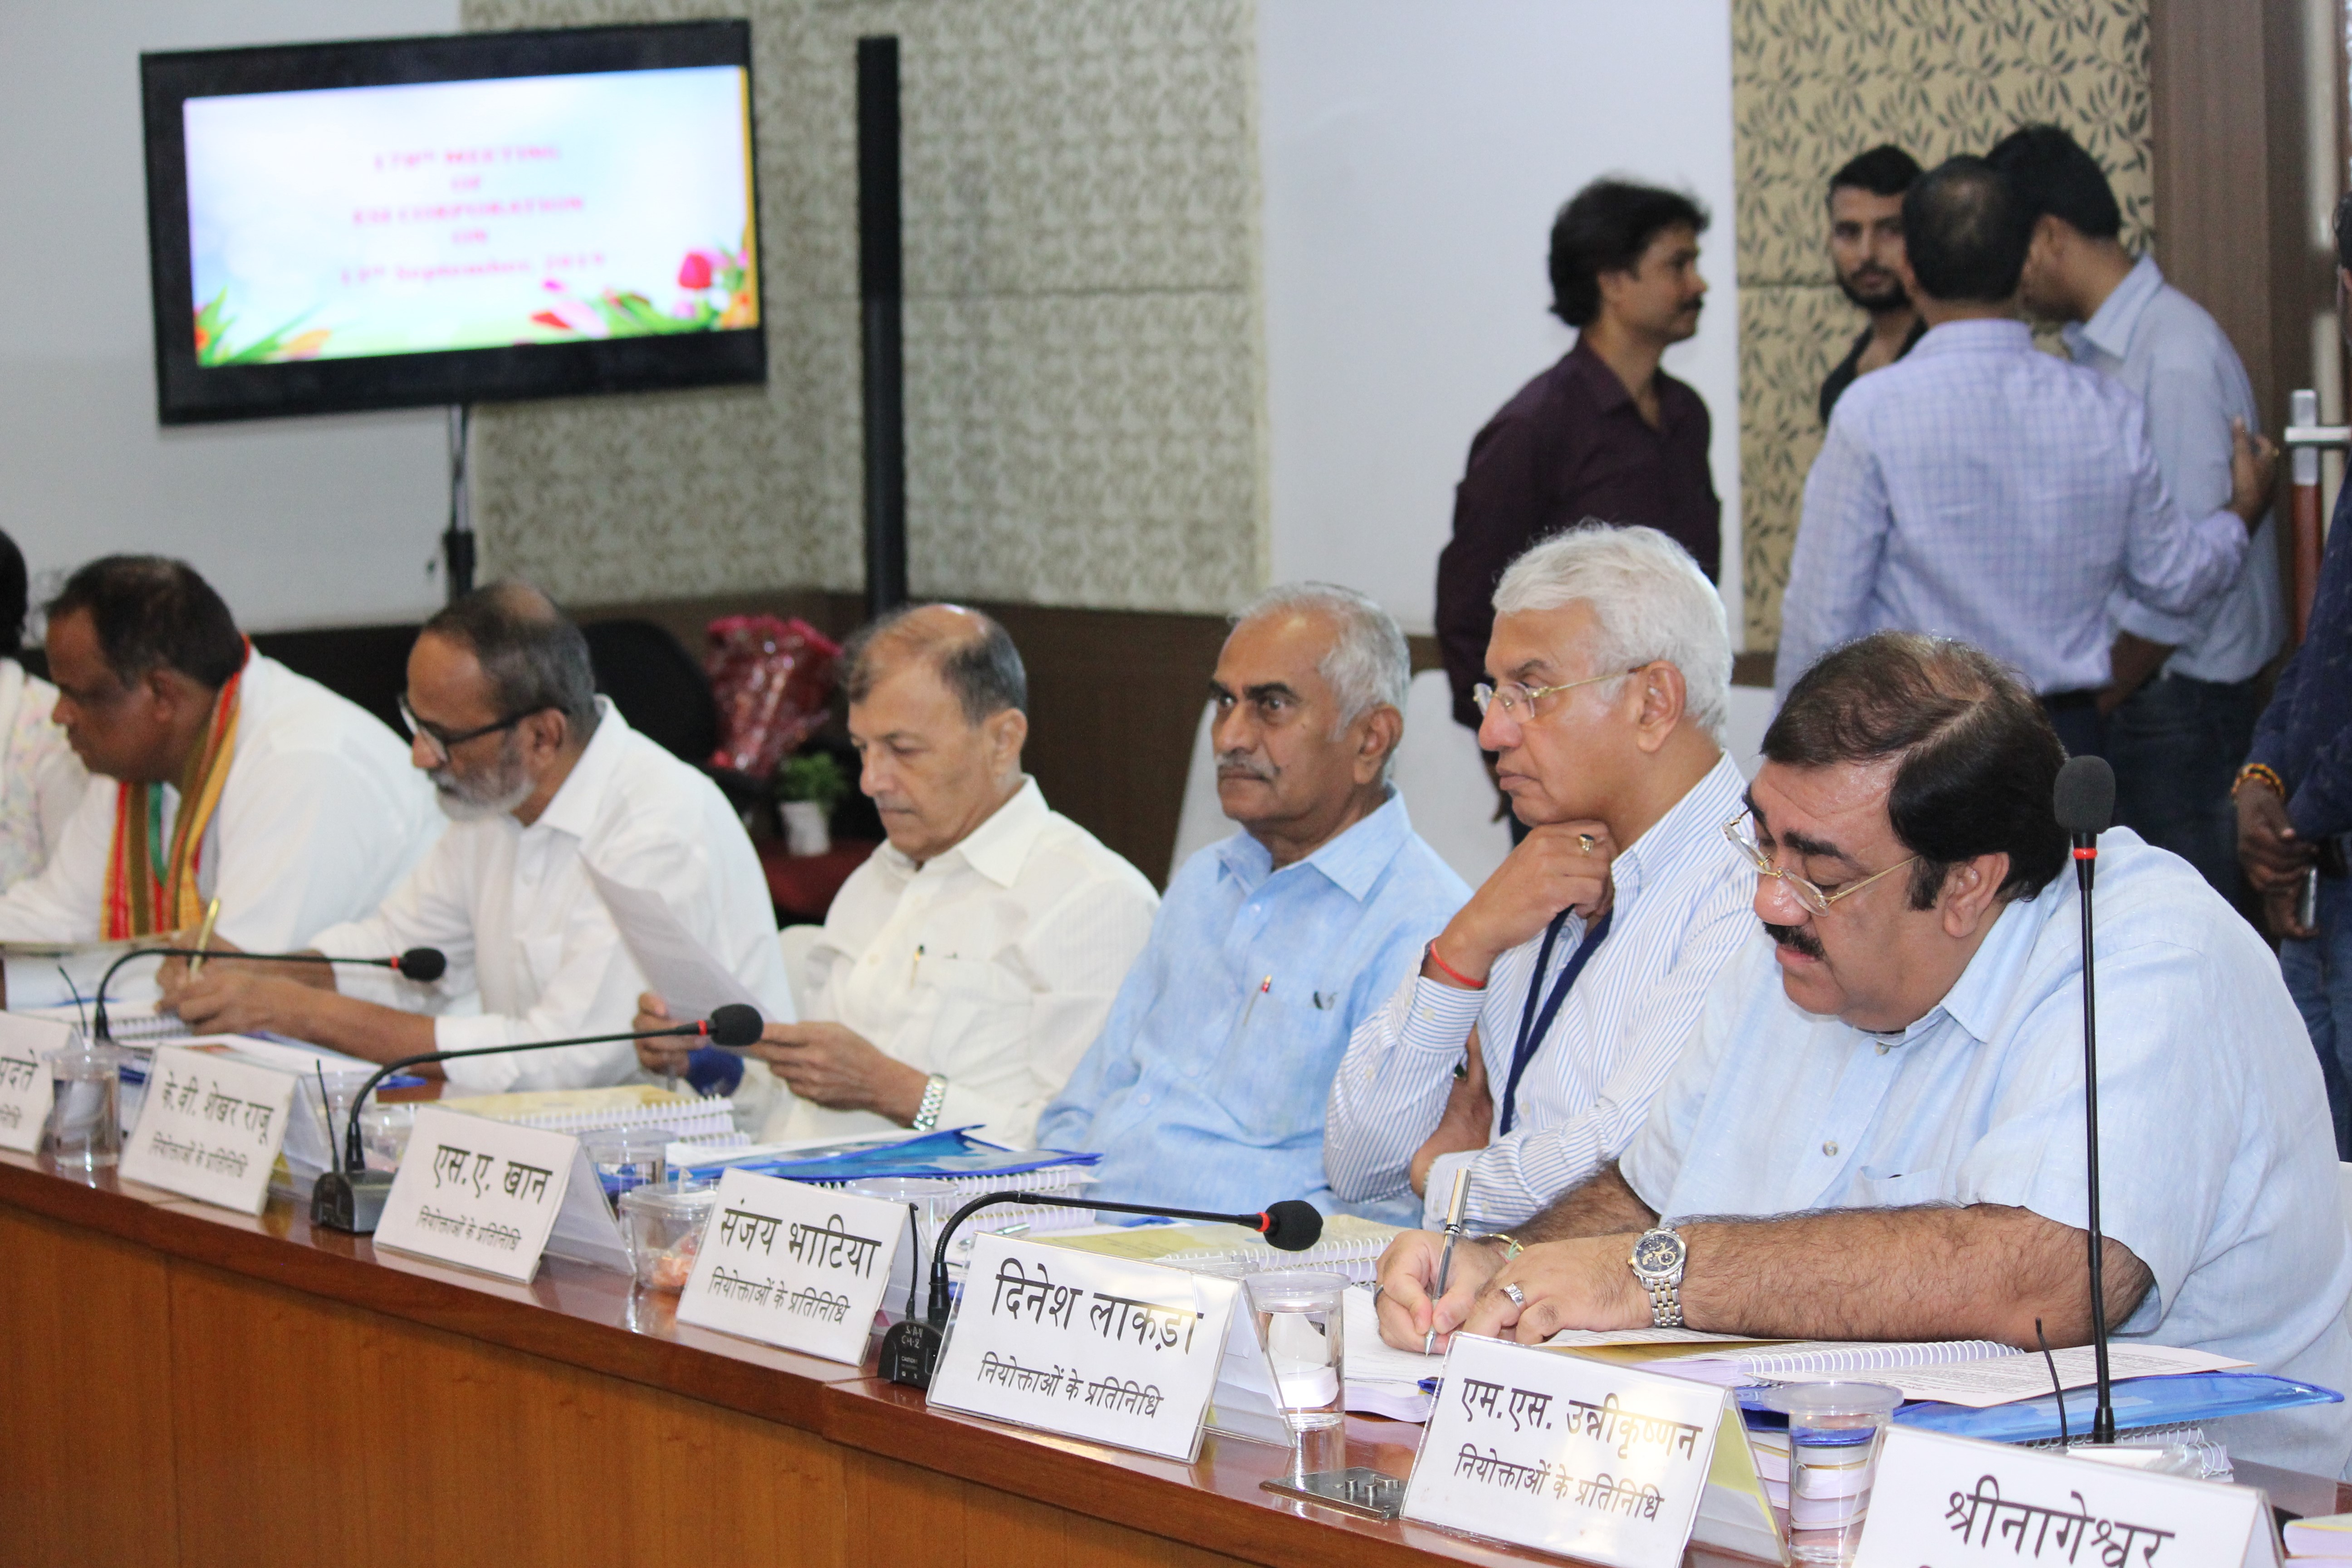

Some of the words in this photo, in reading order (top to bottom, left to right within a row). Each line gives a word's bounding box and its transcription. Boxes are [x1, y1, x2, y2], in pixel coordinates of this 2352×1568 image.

[434, 1144, 495, 1198] एस.ए.
[504, 1161, 553, 1205] खान
[721, 1198, 783, 1256] संजय
[789, 1213, 882, 1279] भाटिया
[708, 1266, 774, 1307] नियोक्ताओं
[774, 1280, 788, 1309] के
[788, 1287, 851, 1325] प्रतिनिधि
[991, 1258, 1083, 1330] दिनेश
[1089, 1292, 1205, 1355] लाकड़ा
[977, 1351, 1064, 1397] नियोक्ताओं
[1065, 1368, 1084, 1401] के
[1085, 1376, 1165, 1419] प्रतिनिधि
[1461, 1378, 1553, 1433] एम.एस.
[1454, 1443, 1551, 1495] नियोक्ताओं
[1553, 1463, 1573, 1500] के
[1574, 1472, 1665, 1522] प्रतिनिधि
